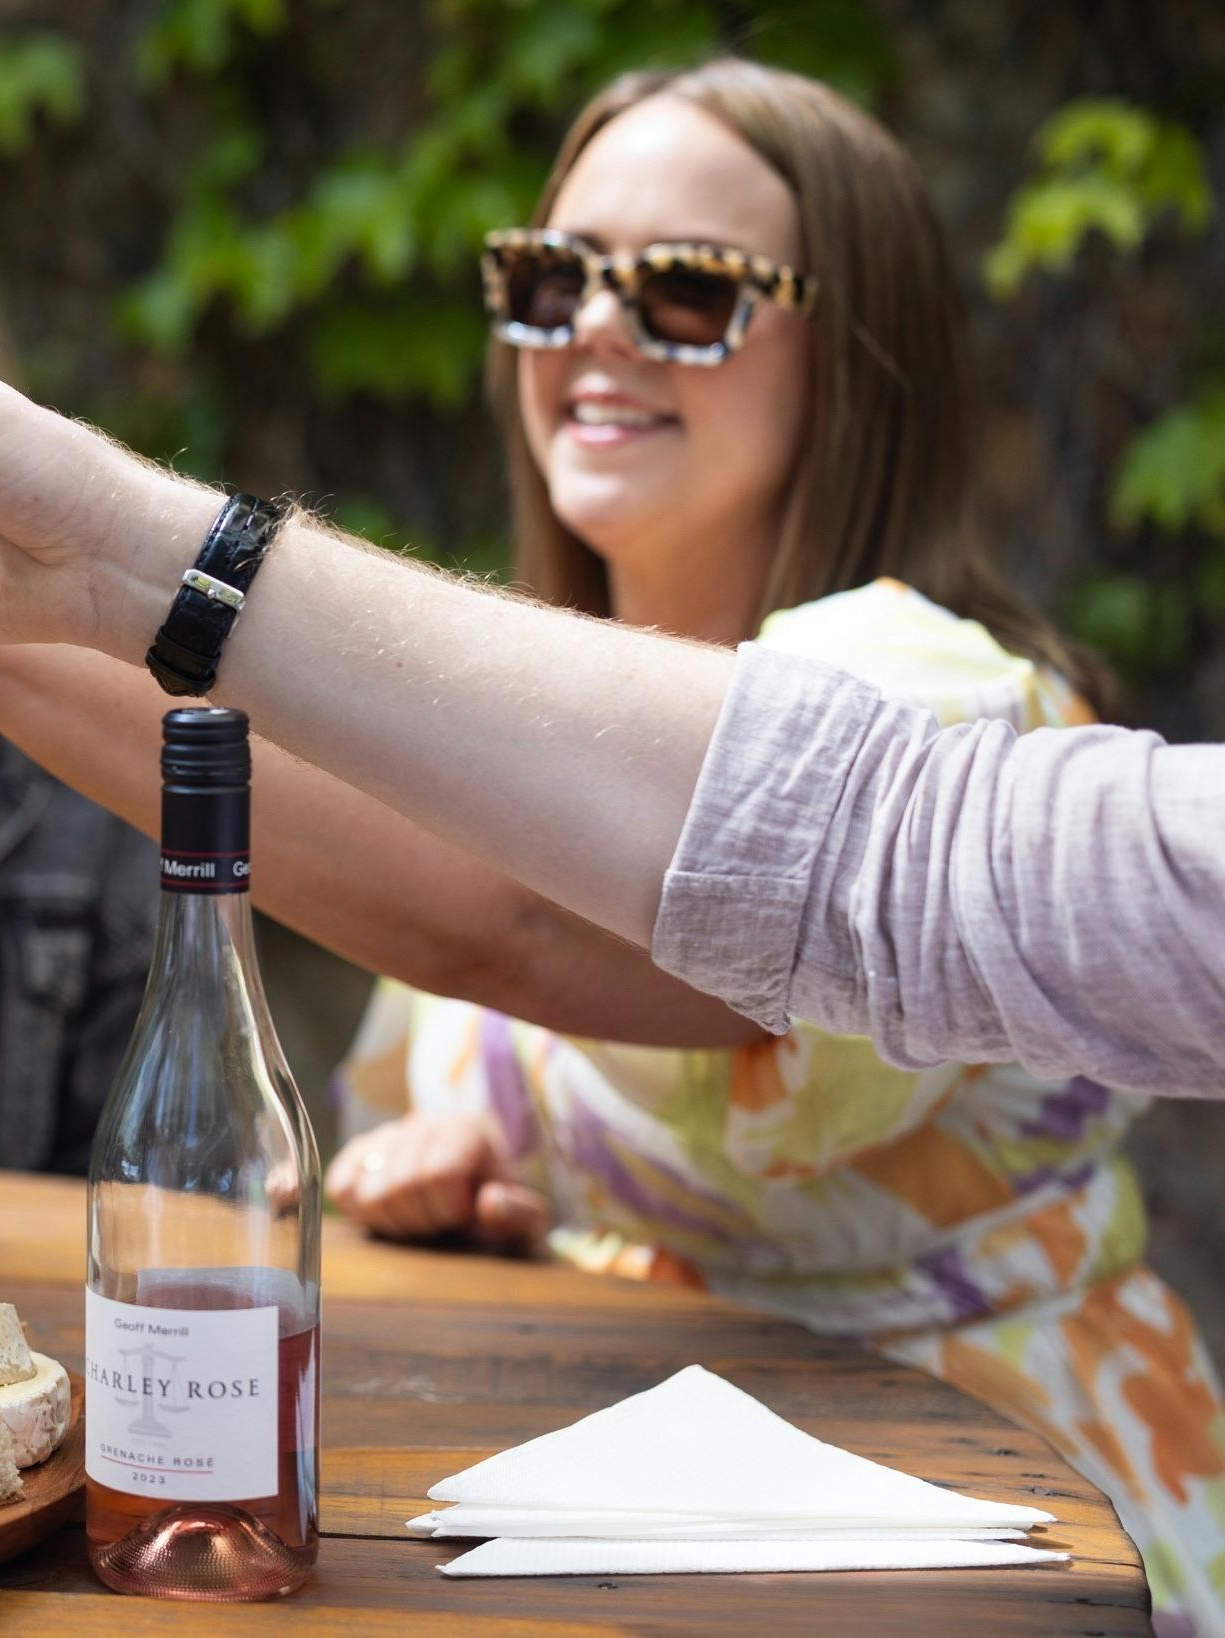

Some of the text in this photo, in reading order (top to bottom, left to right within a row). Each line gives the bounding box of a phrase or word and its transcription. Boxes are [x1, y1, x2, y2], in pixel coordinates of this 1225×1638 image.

[164, 860, 215, 877] Merrill
[114, 1318, 189, 1336] Geoff Merrill
[188, 1377, 261, 1399] ROSE
[100, 1444, 215, 1468] GRENACHE ROSÉ
[132, 1472, 165, 1484] 2023
